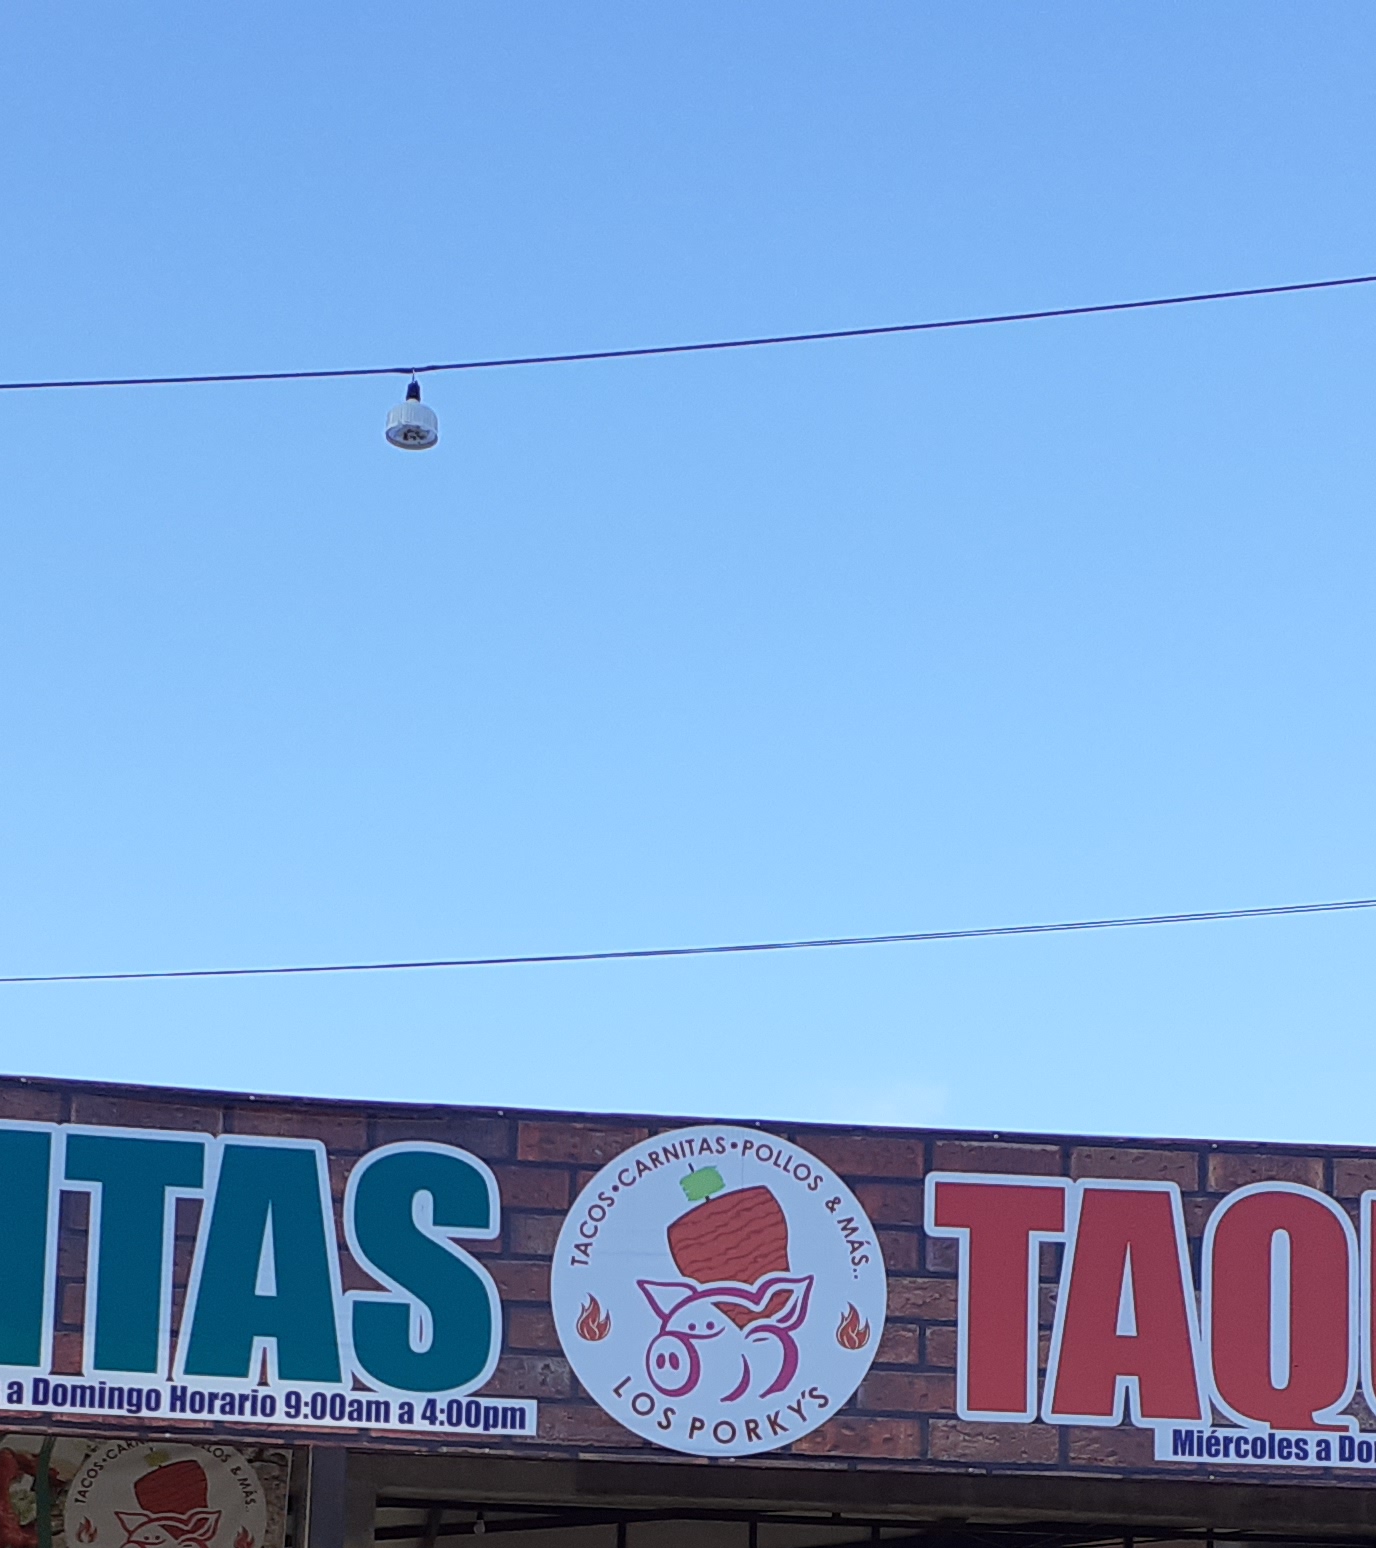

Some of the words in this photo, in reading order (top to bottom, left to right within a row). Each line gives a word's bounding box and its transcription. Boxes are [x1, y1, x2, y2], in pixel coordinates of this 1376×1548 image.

[571, 1194, 615, 1267] TACOS
[618, 1137, 726, 1187] CARNITAS
[742, 1140, 823, 1192] POLLOS
[825, 1196, 841, 1212] &
[7, 1380, 24, 1405] a
[32, 1377, 161, 1415] Domingo
[169, 1385, 275, 1417] Horario
[284, 1390, 391, 1424] 9:00am
[398, 1400, 414, 1425] a
[421, 1398, 526, 1431] 4:00pm
[613, 1376, 676, 1430] LOS
[689, 1387, 829, 1444] PORKY'S
[1172, 1429, 1309, 1461] Miércoles
[1315, 1437, 1332, 1462] a
[74, 1461, 104, 1504] TACOS
